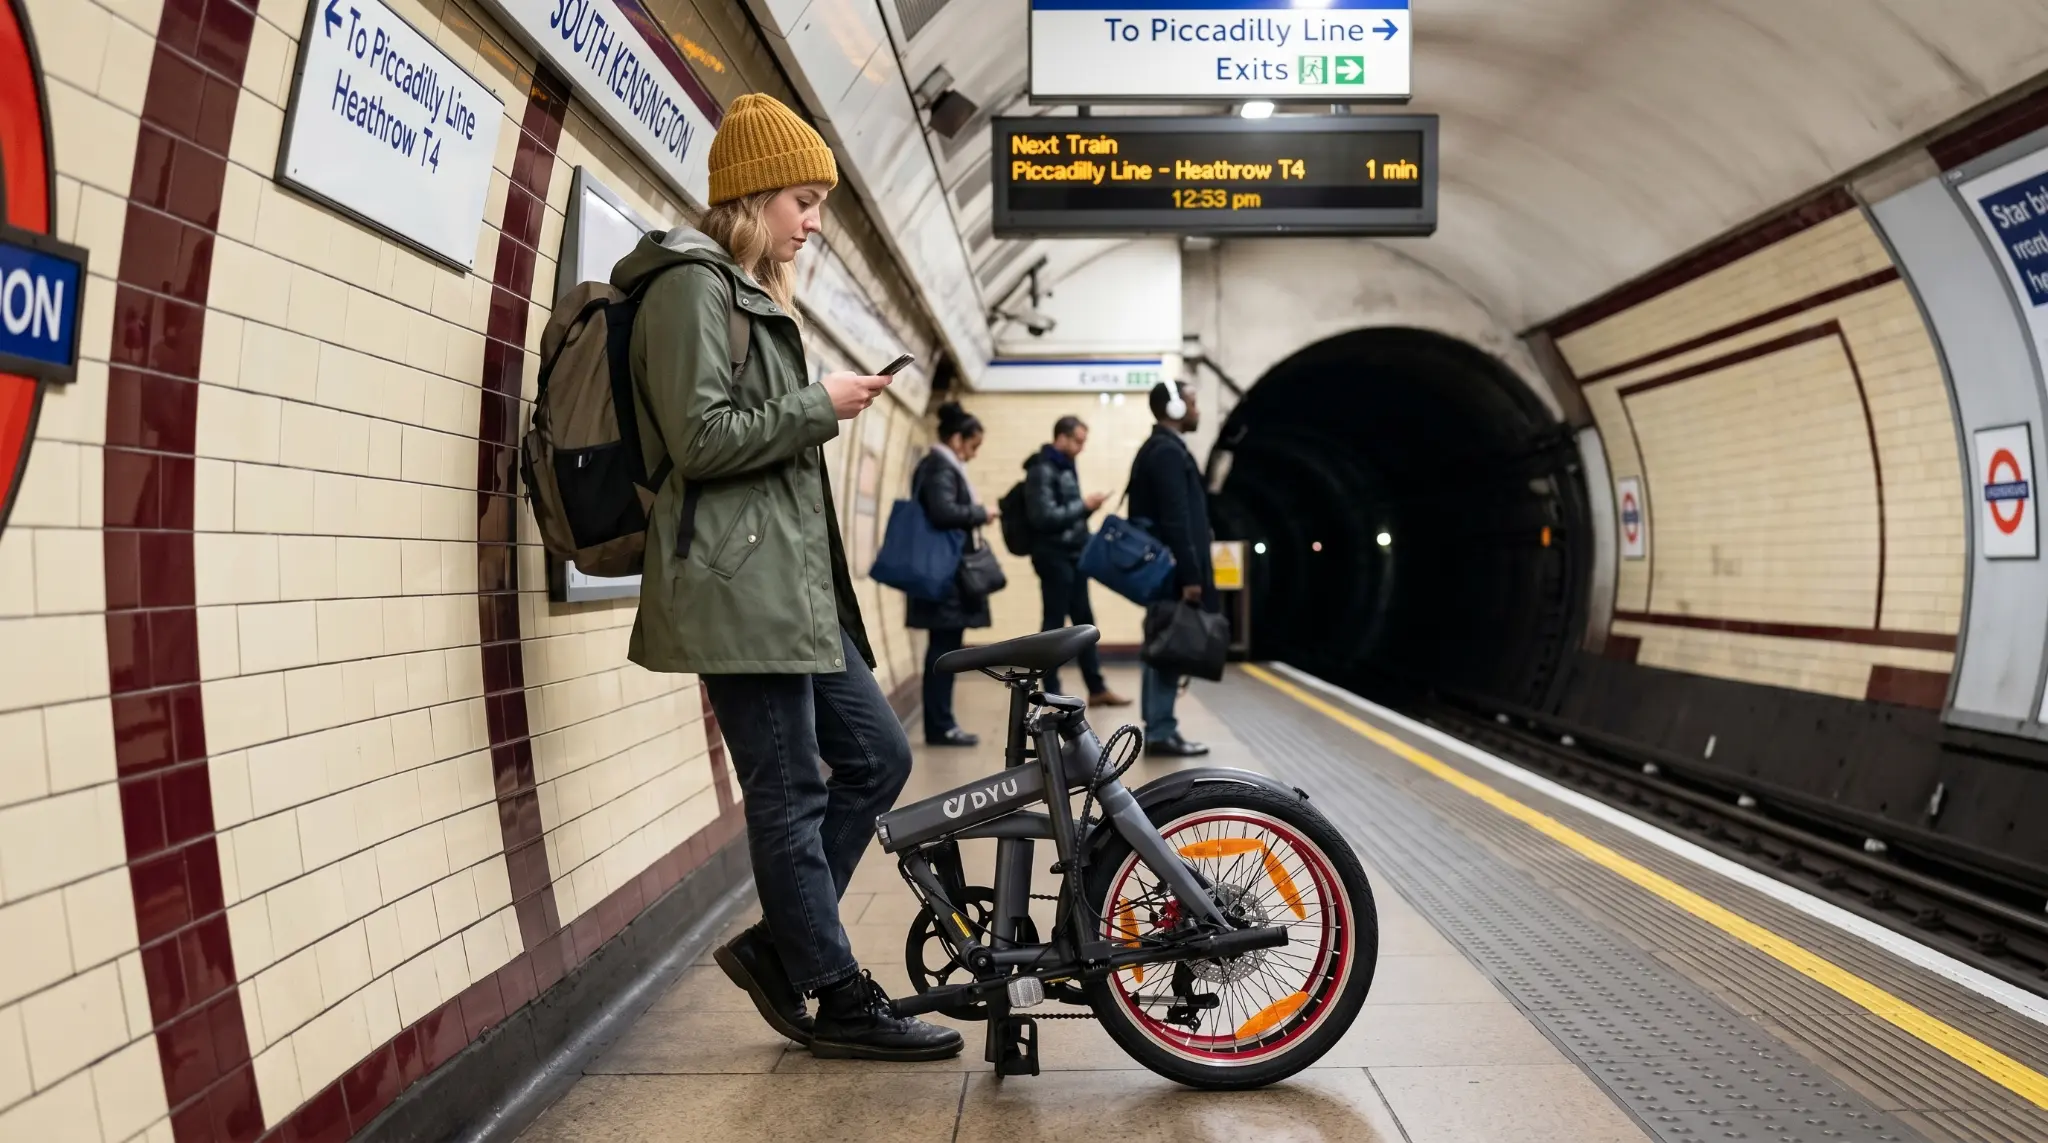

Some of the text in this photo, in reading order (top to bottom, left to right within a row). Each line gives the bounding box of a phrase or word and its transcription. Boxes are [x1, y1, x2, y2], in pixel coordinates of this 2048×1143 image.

[1105, 18, 1364, 48] To Piccadilly Line
[347, 6, 476, 141] To Piccadilly Line
[1217, 57, 1289, 80] Exits
[606, 41, 695, 164] KENSINGTON
[332, 68, 442, 174] Heathrow T4
[1012, 134, 1118, 155] Next Train
[1012, 160, 1105, 185] Piccadilly
[1111, 160, 1152, 181] Line
[1175, 159, 1272, 181] Heathrow
[1278, 159, 1306, 180] T4
[1366, 159, 1376, 180] 1
[1383, 159, 1418, 180] min
[1171, 188, 1262, 211] 12:53 pm
[1991, 201, 2032, 229] Star
[0, 267, 64, 342] ON
[970, 778, 1018, 810] DYU
